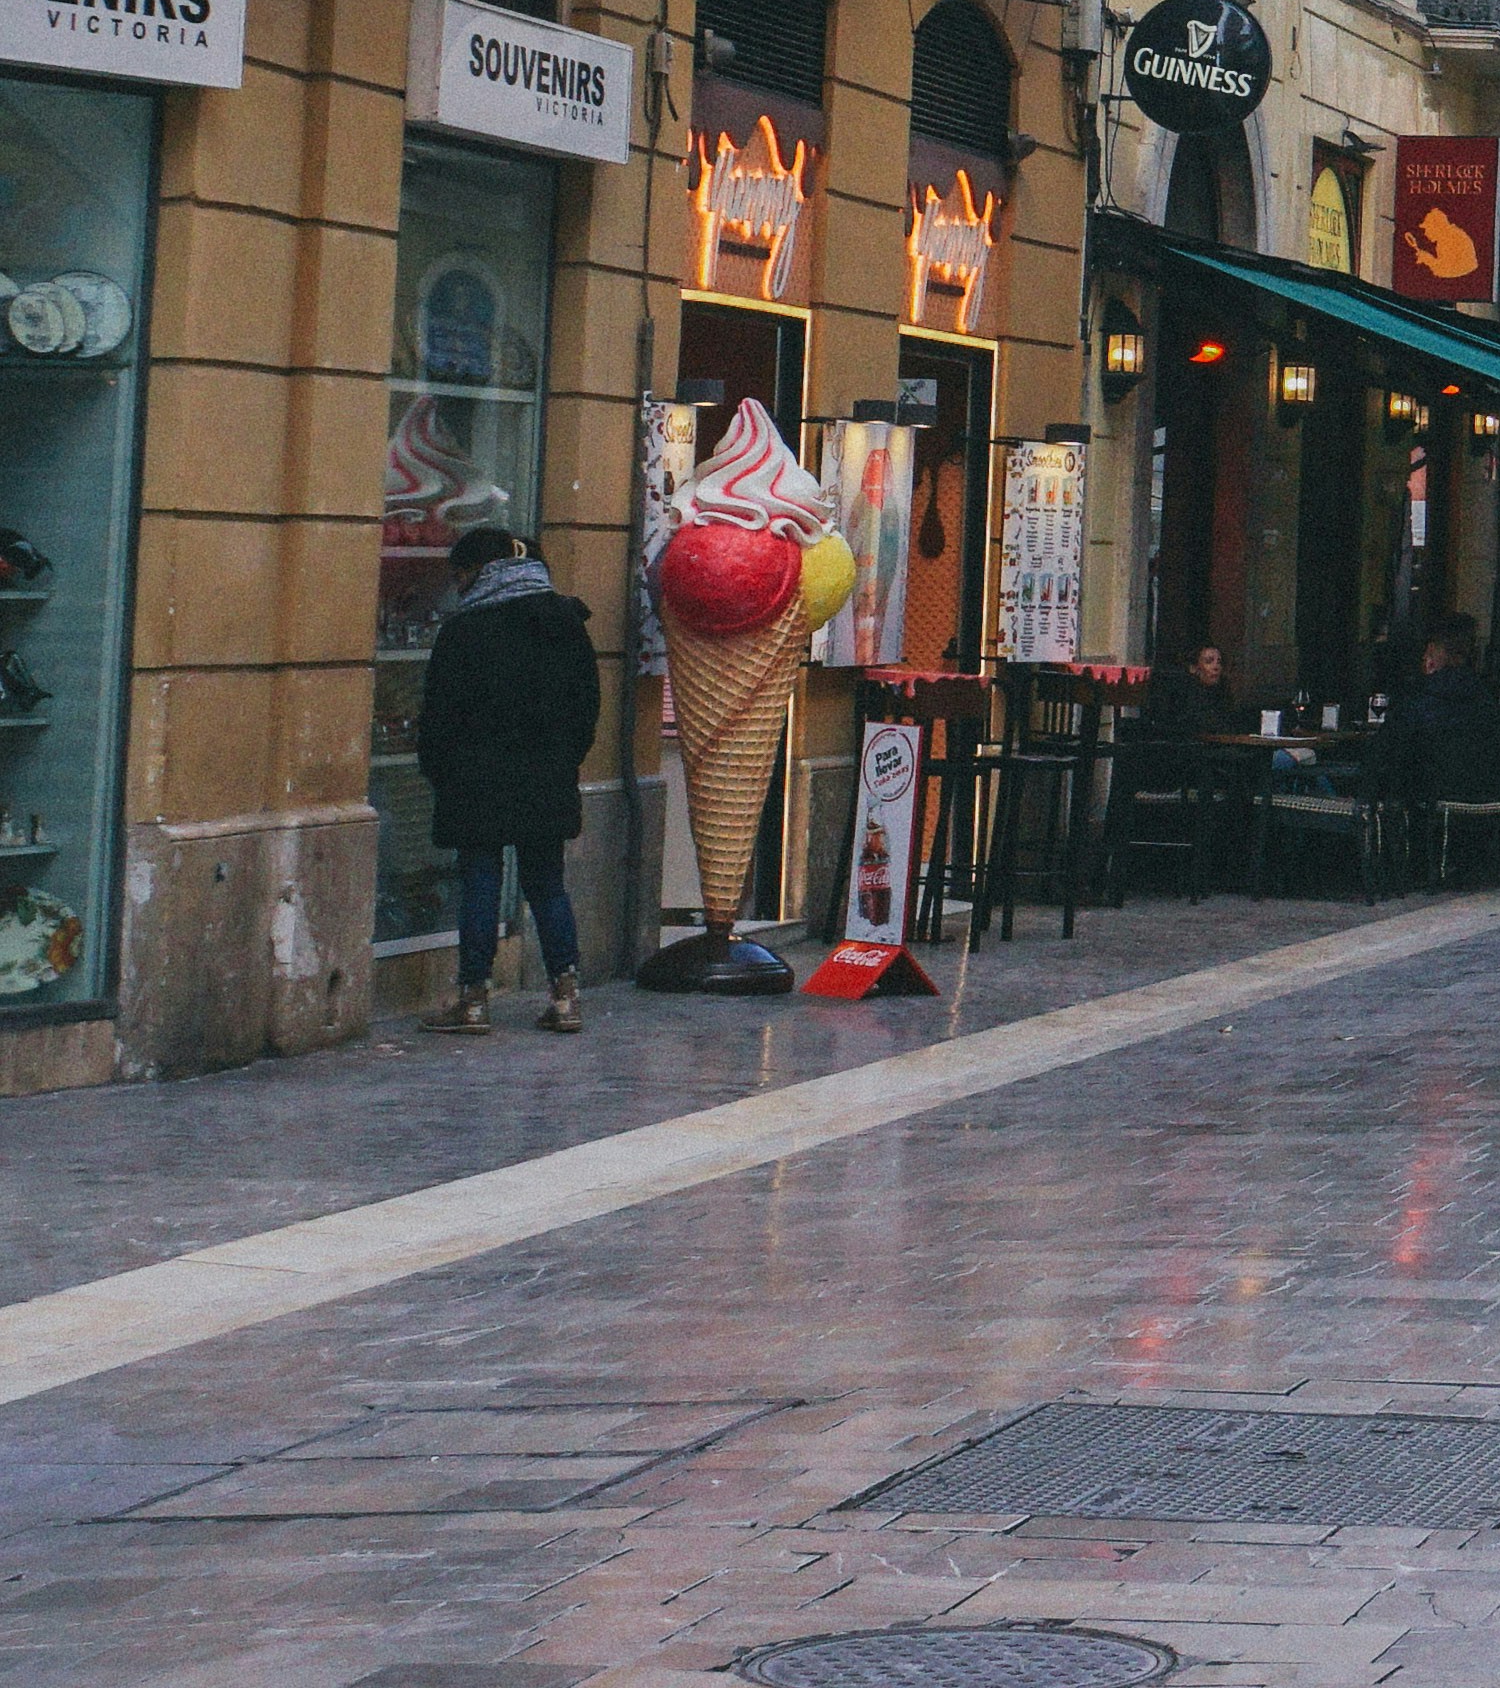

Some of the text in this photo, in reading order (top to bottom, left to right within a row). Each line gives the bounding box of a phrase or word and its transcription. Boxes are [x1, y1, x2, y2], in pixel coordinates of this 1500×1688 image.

[47, 9, 209, 48] VICTORIA
[469, 33, 606, 107] SOUVENIRS
[1133, 47, 1253, 97] GUINNESS
[535, 97, 604, 126] VICTORIA
[875, 744, 898, 766] Para
